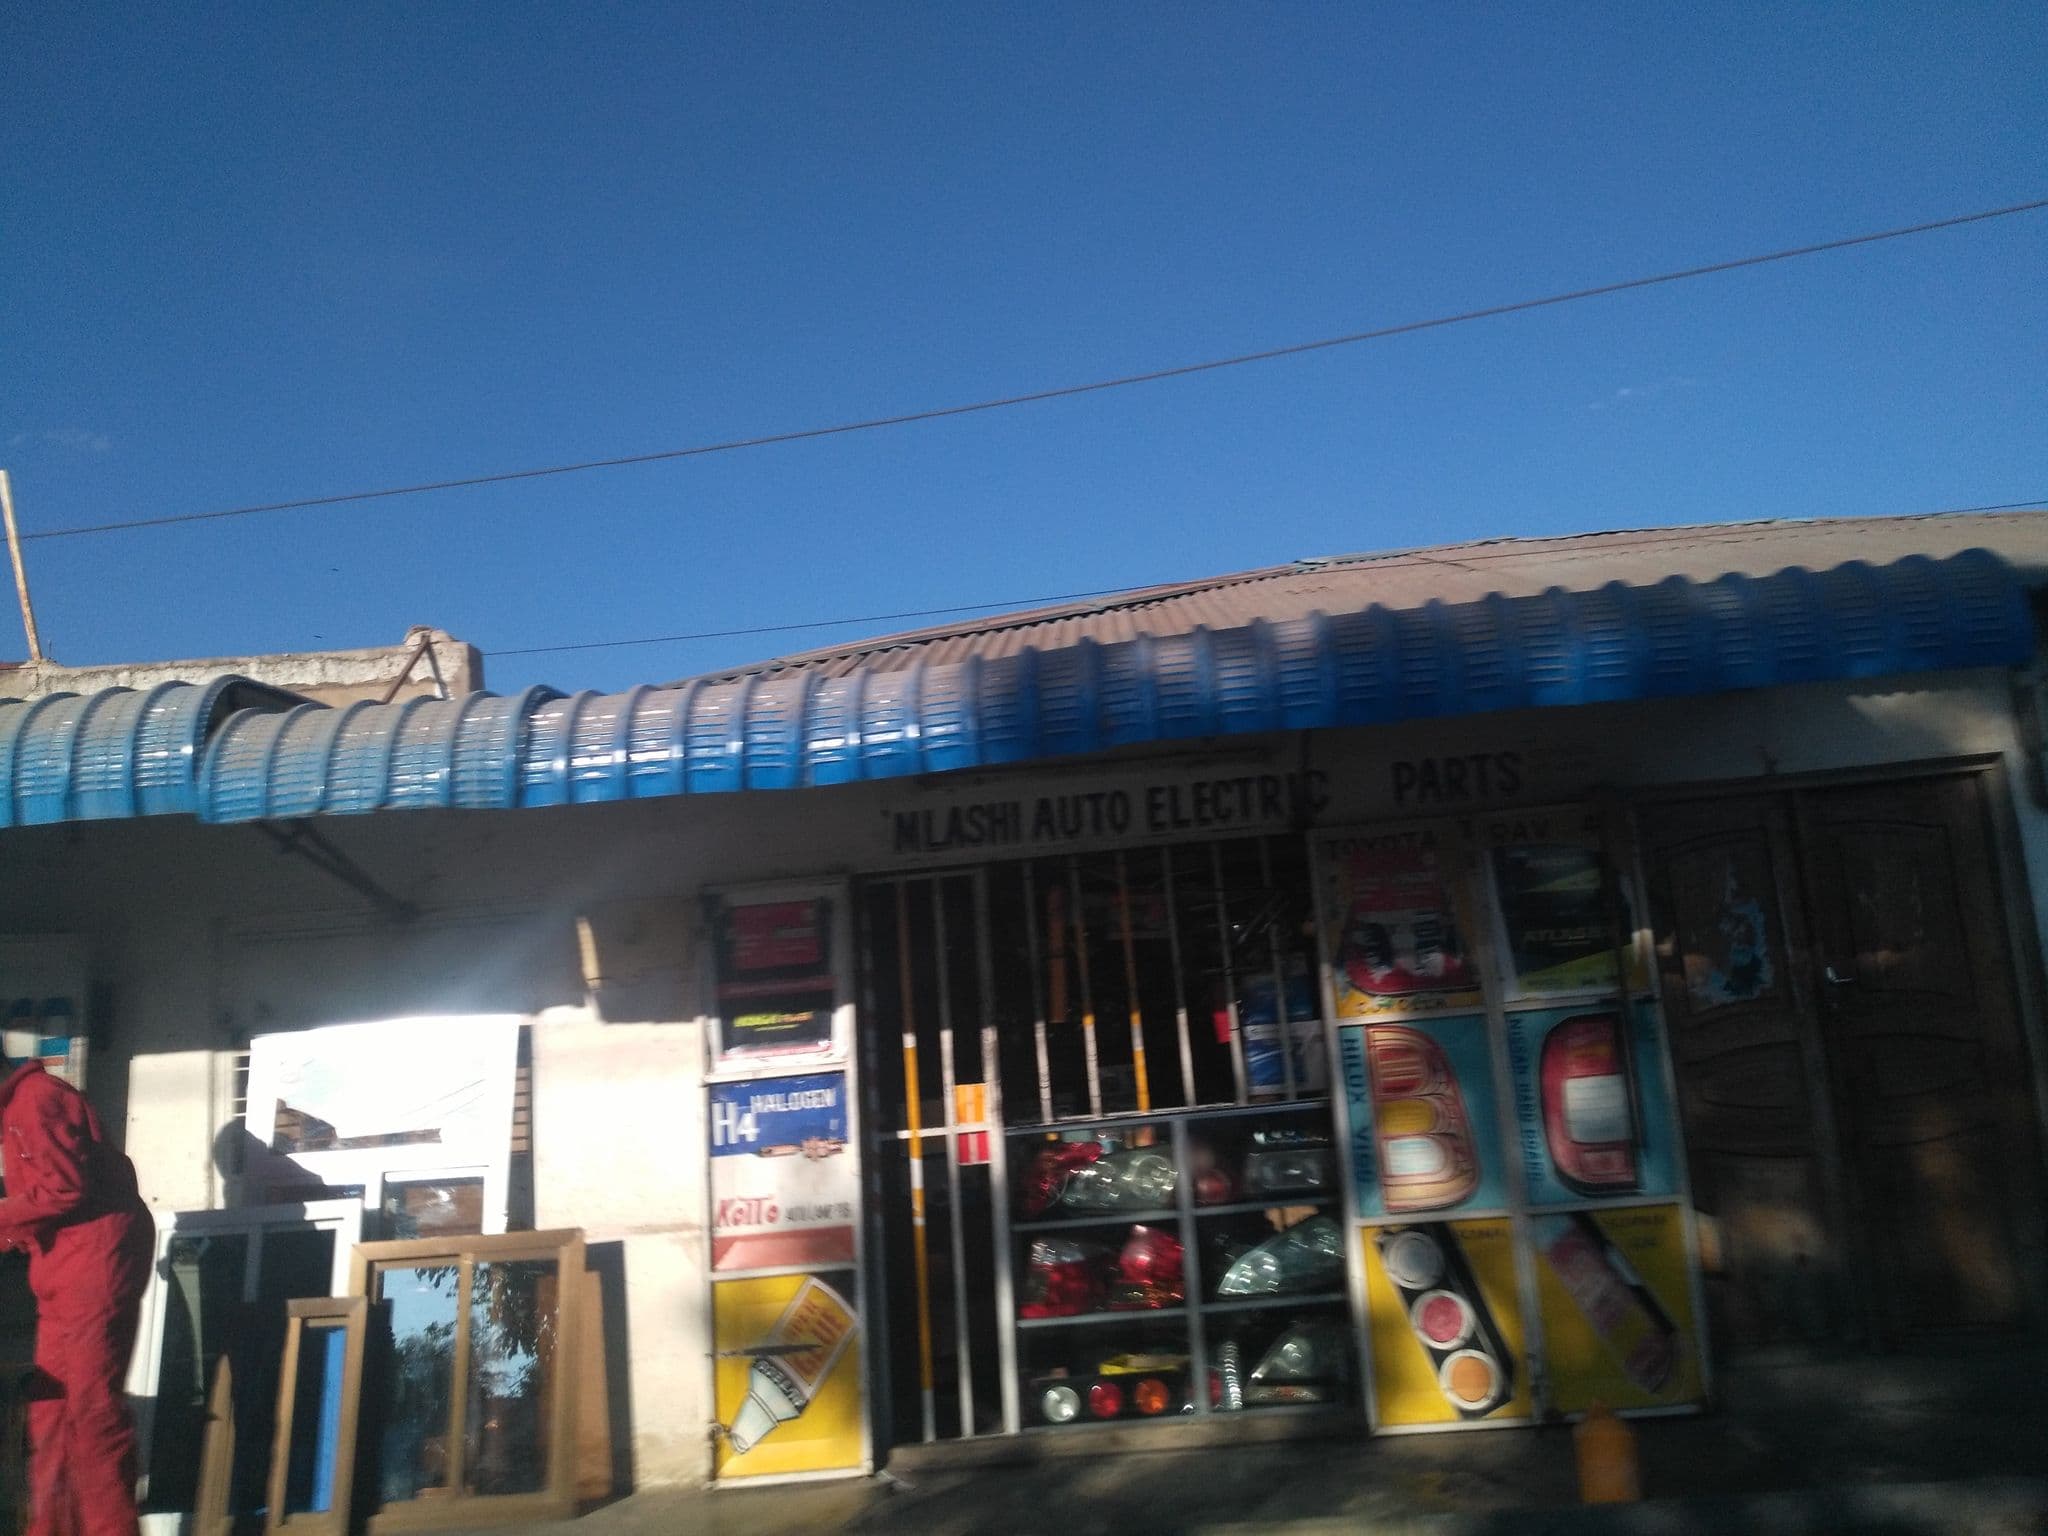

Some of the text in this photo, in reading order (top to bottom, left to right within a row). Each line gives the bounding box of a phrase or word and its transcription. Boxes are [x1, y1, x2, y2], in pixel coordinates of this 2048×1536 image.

[1033, 790, 1130, 841] AUTO
[1147, 768, 1328, 832] ELECTRIC
[1391, 752, 1522, 805] PARTS
[750, 1088, 837, 1113] HALOGEN
[711, 1102, 760, 1146] H4
